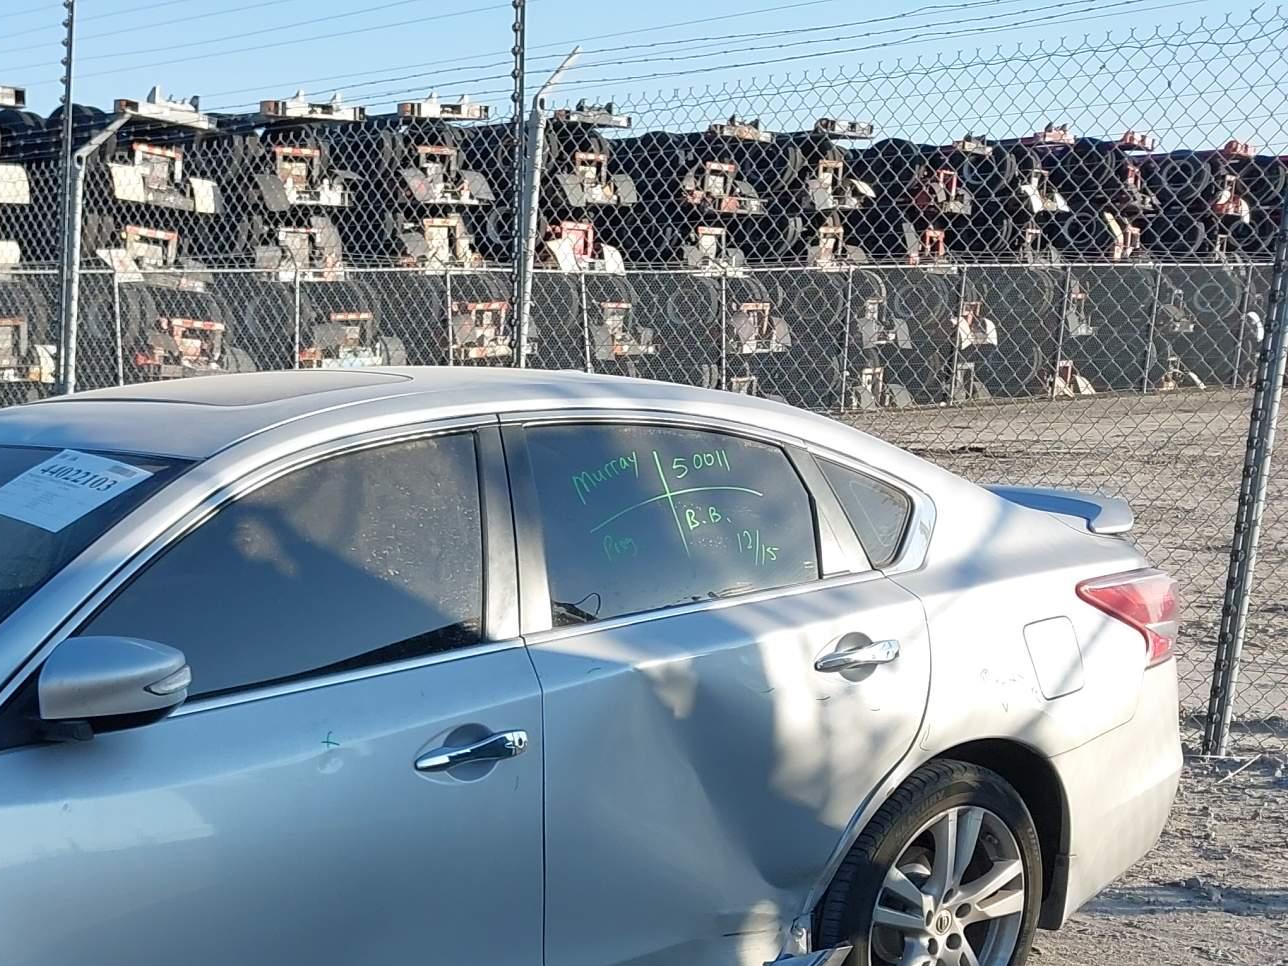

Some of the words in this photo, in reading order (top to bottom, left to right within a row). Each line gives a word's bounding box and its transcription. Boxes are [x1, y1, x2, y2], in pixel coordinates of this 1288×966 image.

[39, 463, 118, 492] 44022103
[572, 451, 639, 505] Murray
[736, 529, 780, 565] 12/15
